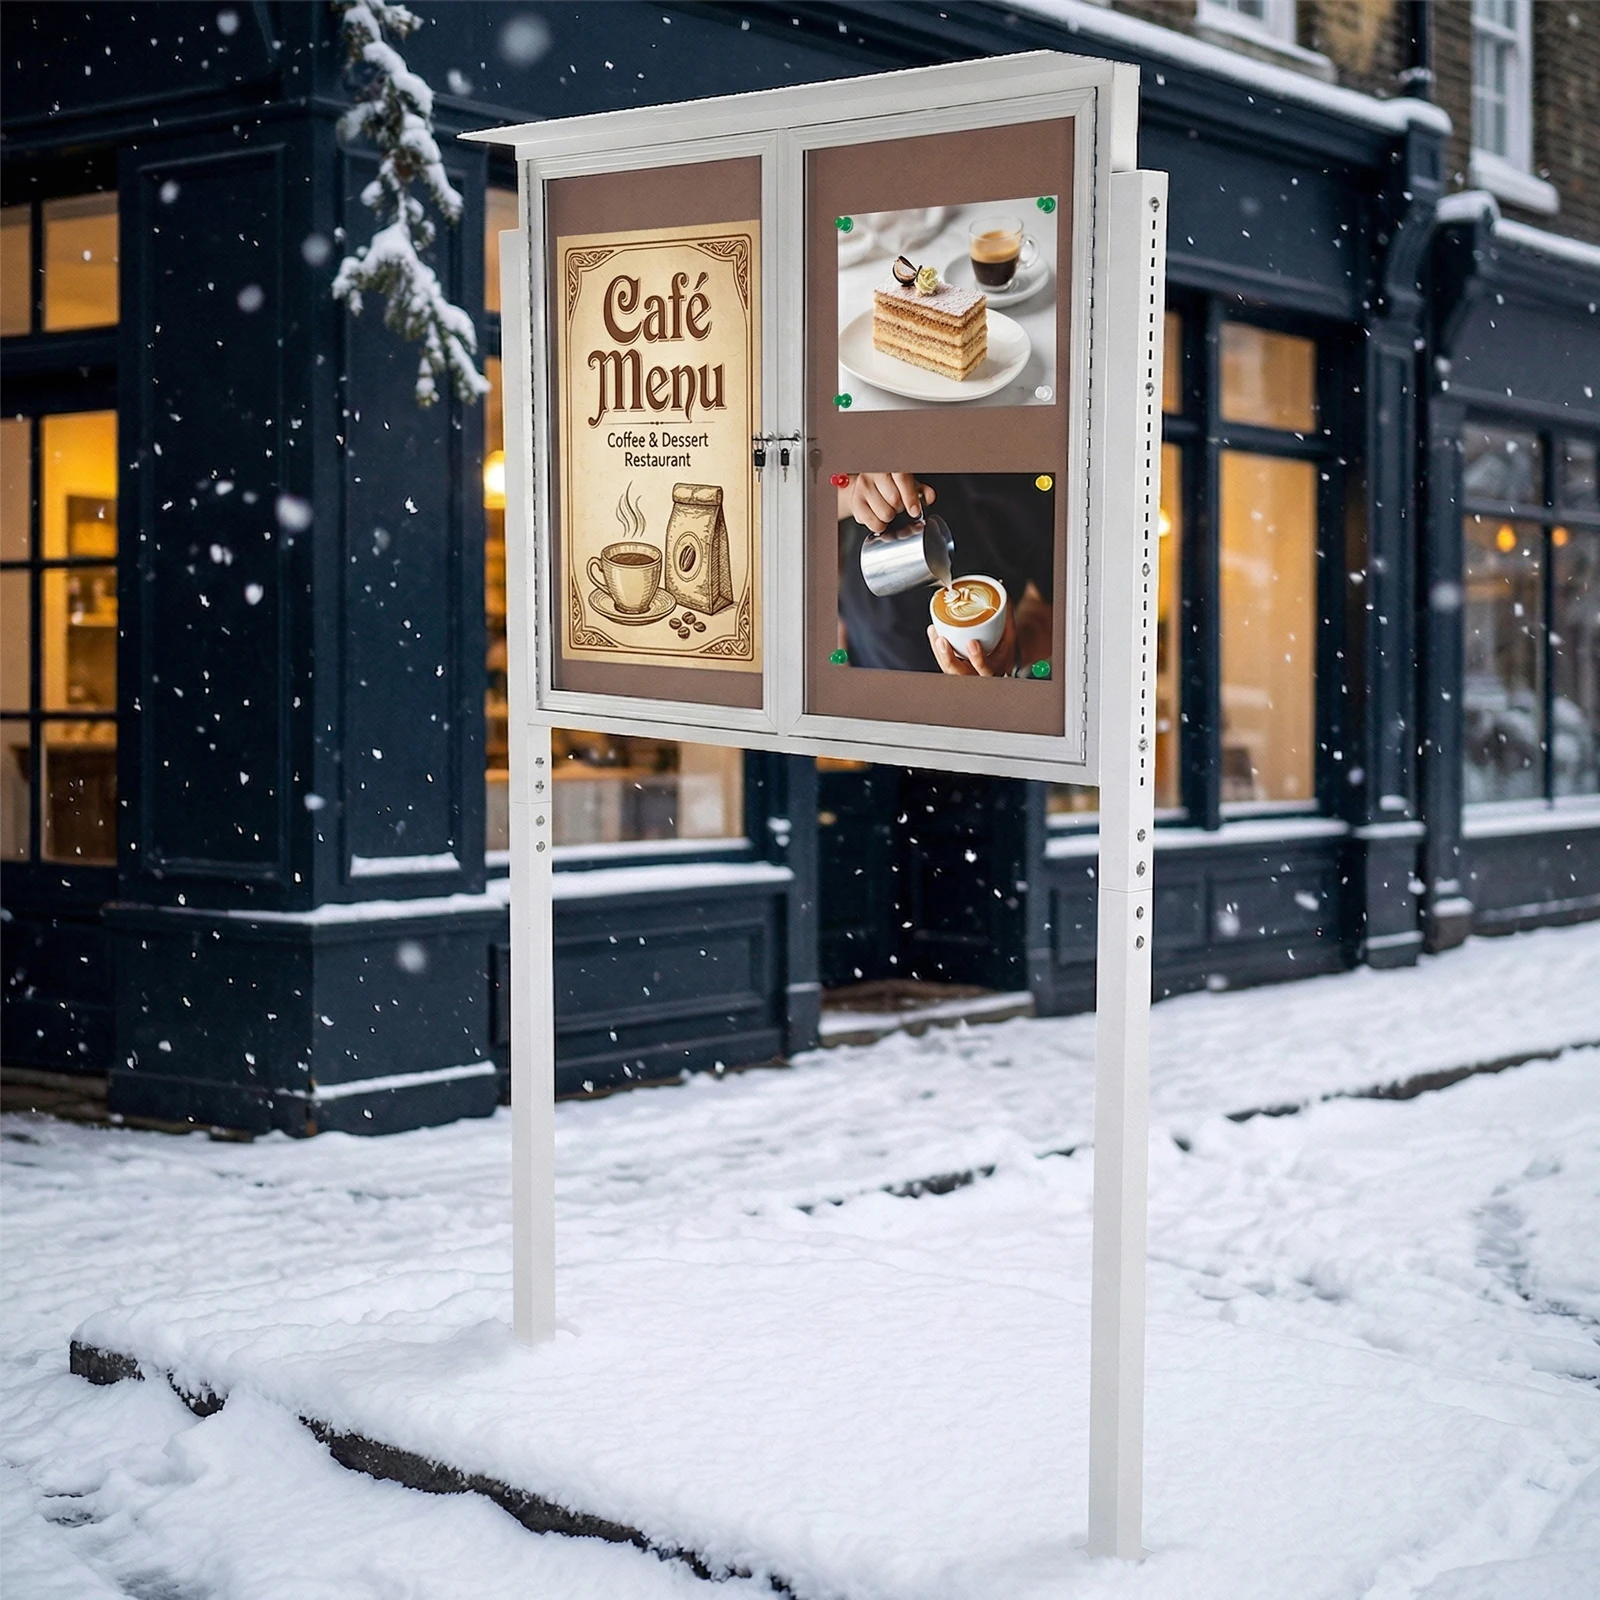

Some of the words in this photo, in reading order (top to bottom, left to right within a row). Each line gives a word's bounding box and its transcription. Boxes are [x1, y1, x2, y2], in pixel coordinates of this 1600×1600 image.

[603, 271, 712, 345] Café
[587, 348, 726, 428] Menu
[607, 431, 646, 448] Coffee
[649, 431, 659, 448] &
[662, 431, 709, 448] Dessert
[624, 451, 691, 468] Restaurant
